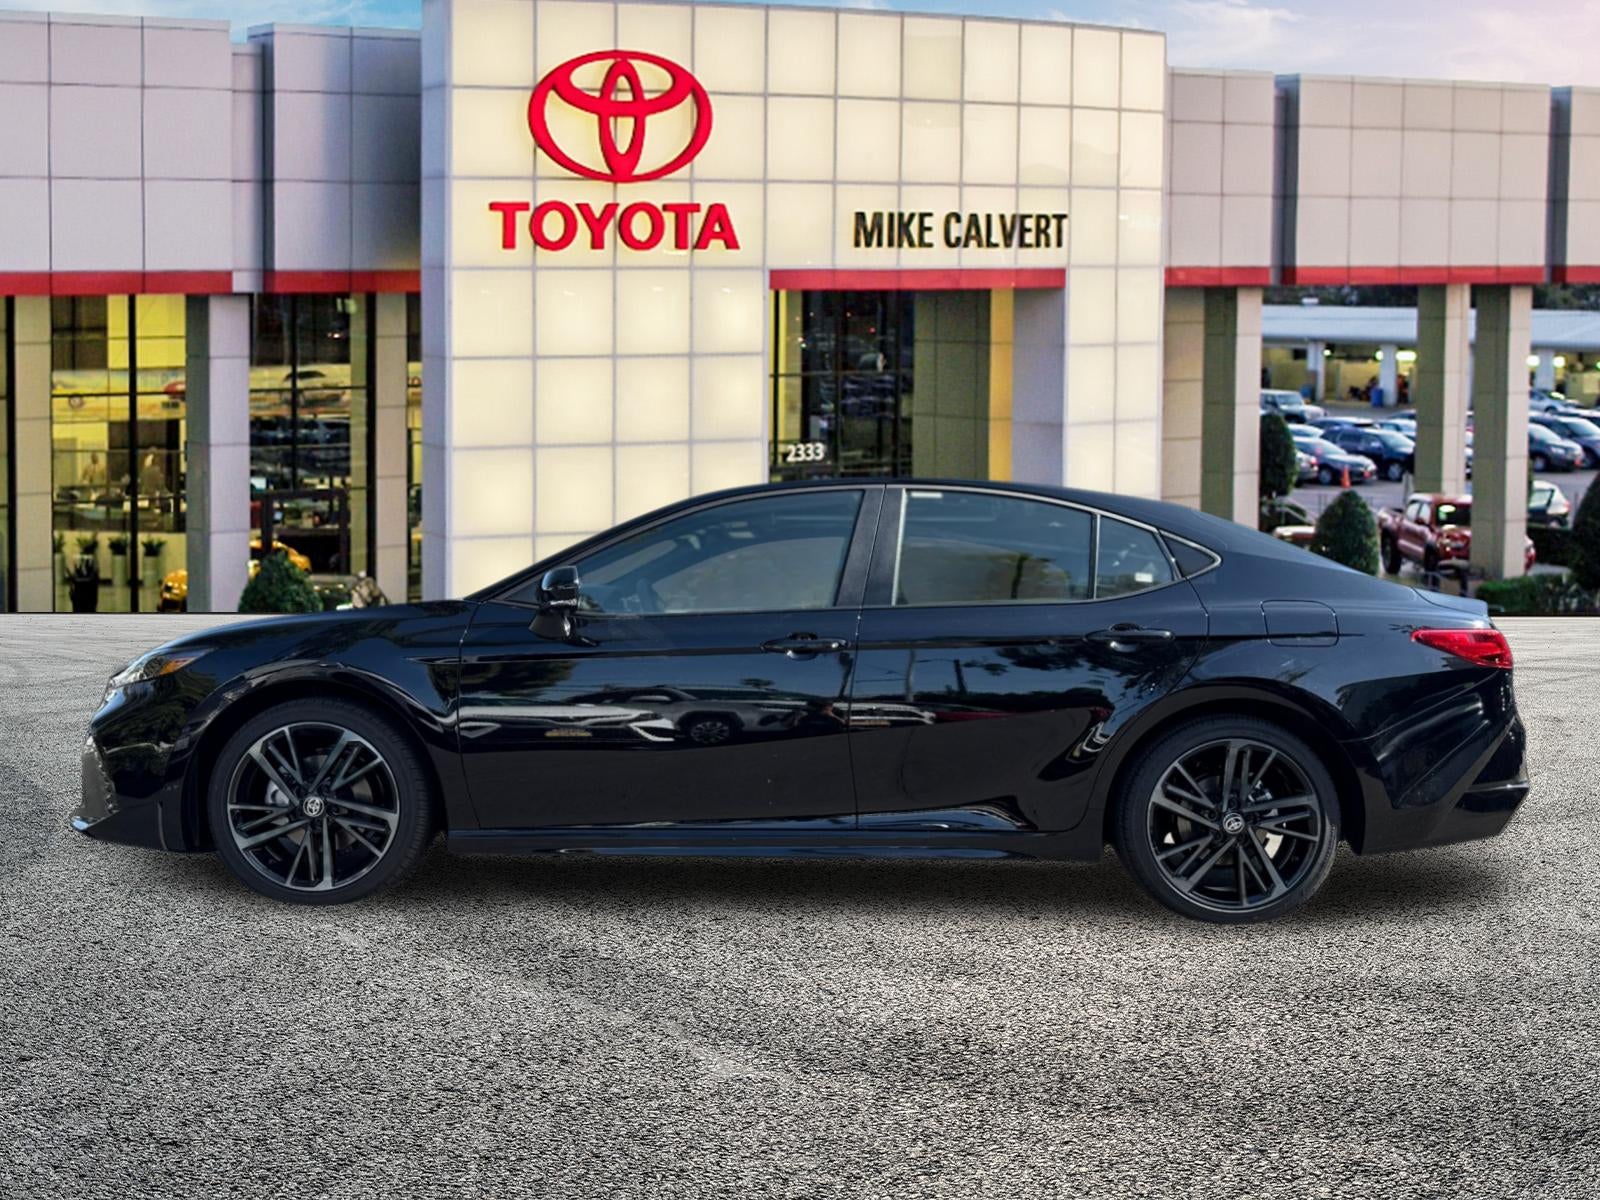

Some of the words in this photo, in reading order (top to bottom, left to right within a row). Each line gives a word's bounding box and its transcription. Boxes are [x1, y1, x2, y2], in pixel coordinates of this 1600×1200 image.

[489, 201, 740, 251] TOYOTA
[853, 211, 934, 249] MIKE
[943, 212, 1068, 249] CALVERT
[786, 442, 825, 462] 2333
